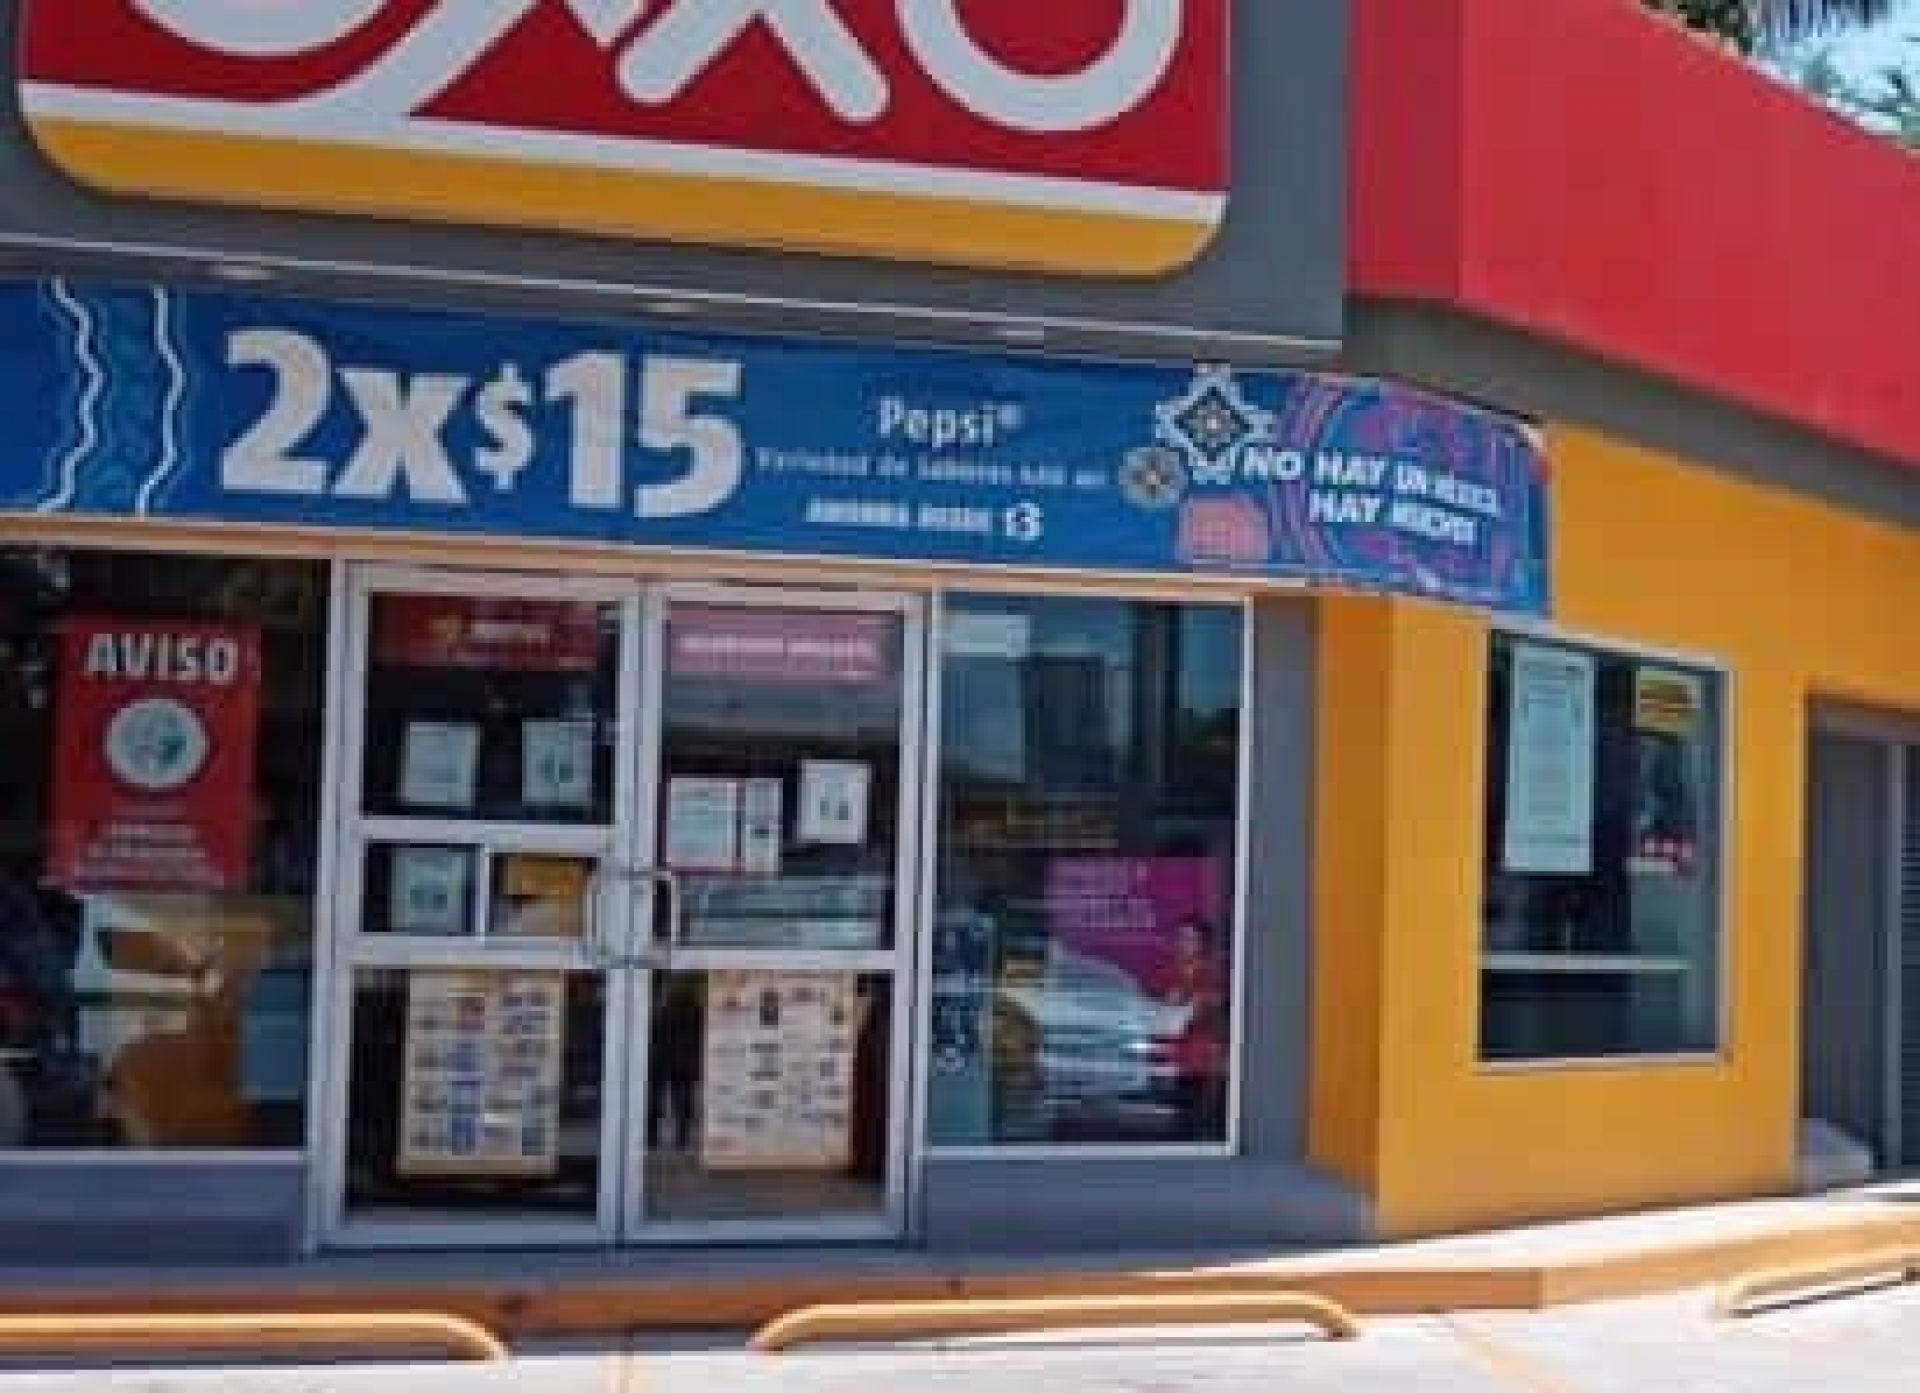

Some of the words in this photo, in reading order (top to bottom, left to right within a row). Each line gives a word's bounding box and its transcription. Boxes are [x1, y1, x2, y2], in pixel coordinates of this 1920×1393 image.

[1243, 446, 1302, 482] NO
[1313, 450, 1388, 486] HAY
[1309, 490, 1383, 524] HAY
[84, 632, 239, 686] AVISO
